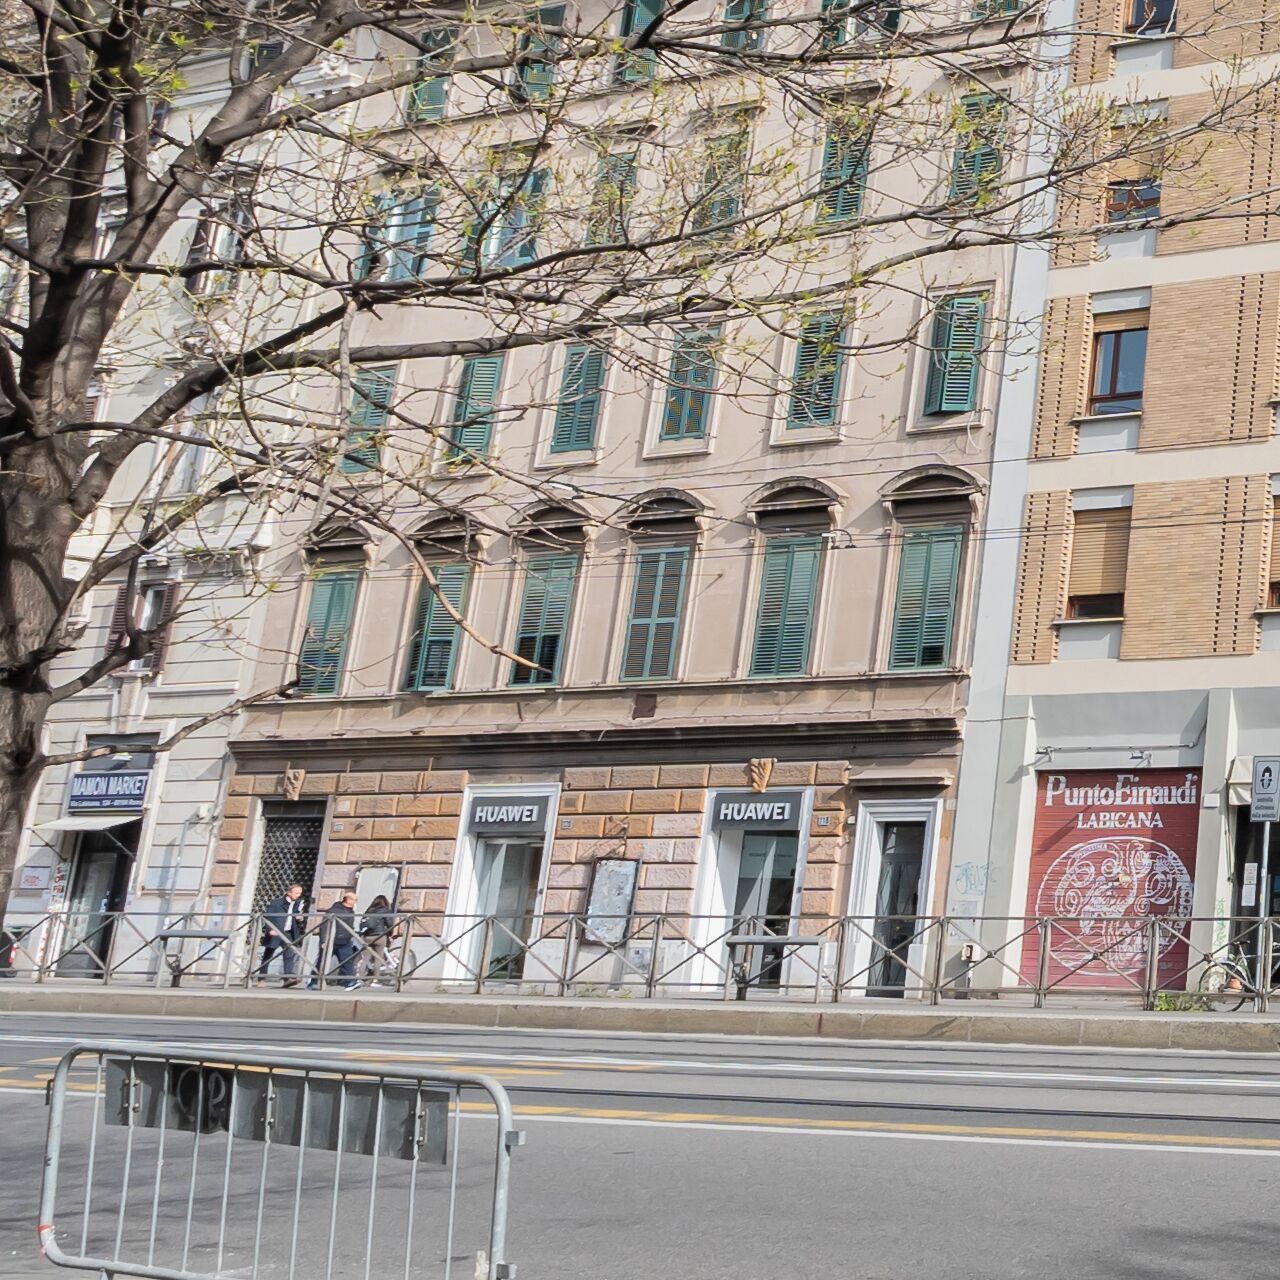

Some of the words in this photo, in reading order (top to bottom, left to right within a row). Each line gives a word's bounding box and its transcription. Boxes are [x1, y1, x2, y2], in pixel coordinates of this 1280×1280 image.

[72, 777, 108, 795] MAMON
[108, 776, 148, 795] MARKET
[474, 805, 539, 822] HUAWEI
[720, 802, 791, 820] HUAWEI
[1076, 811, 1164, 829] LABICANA
